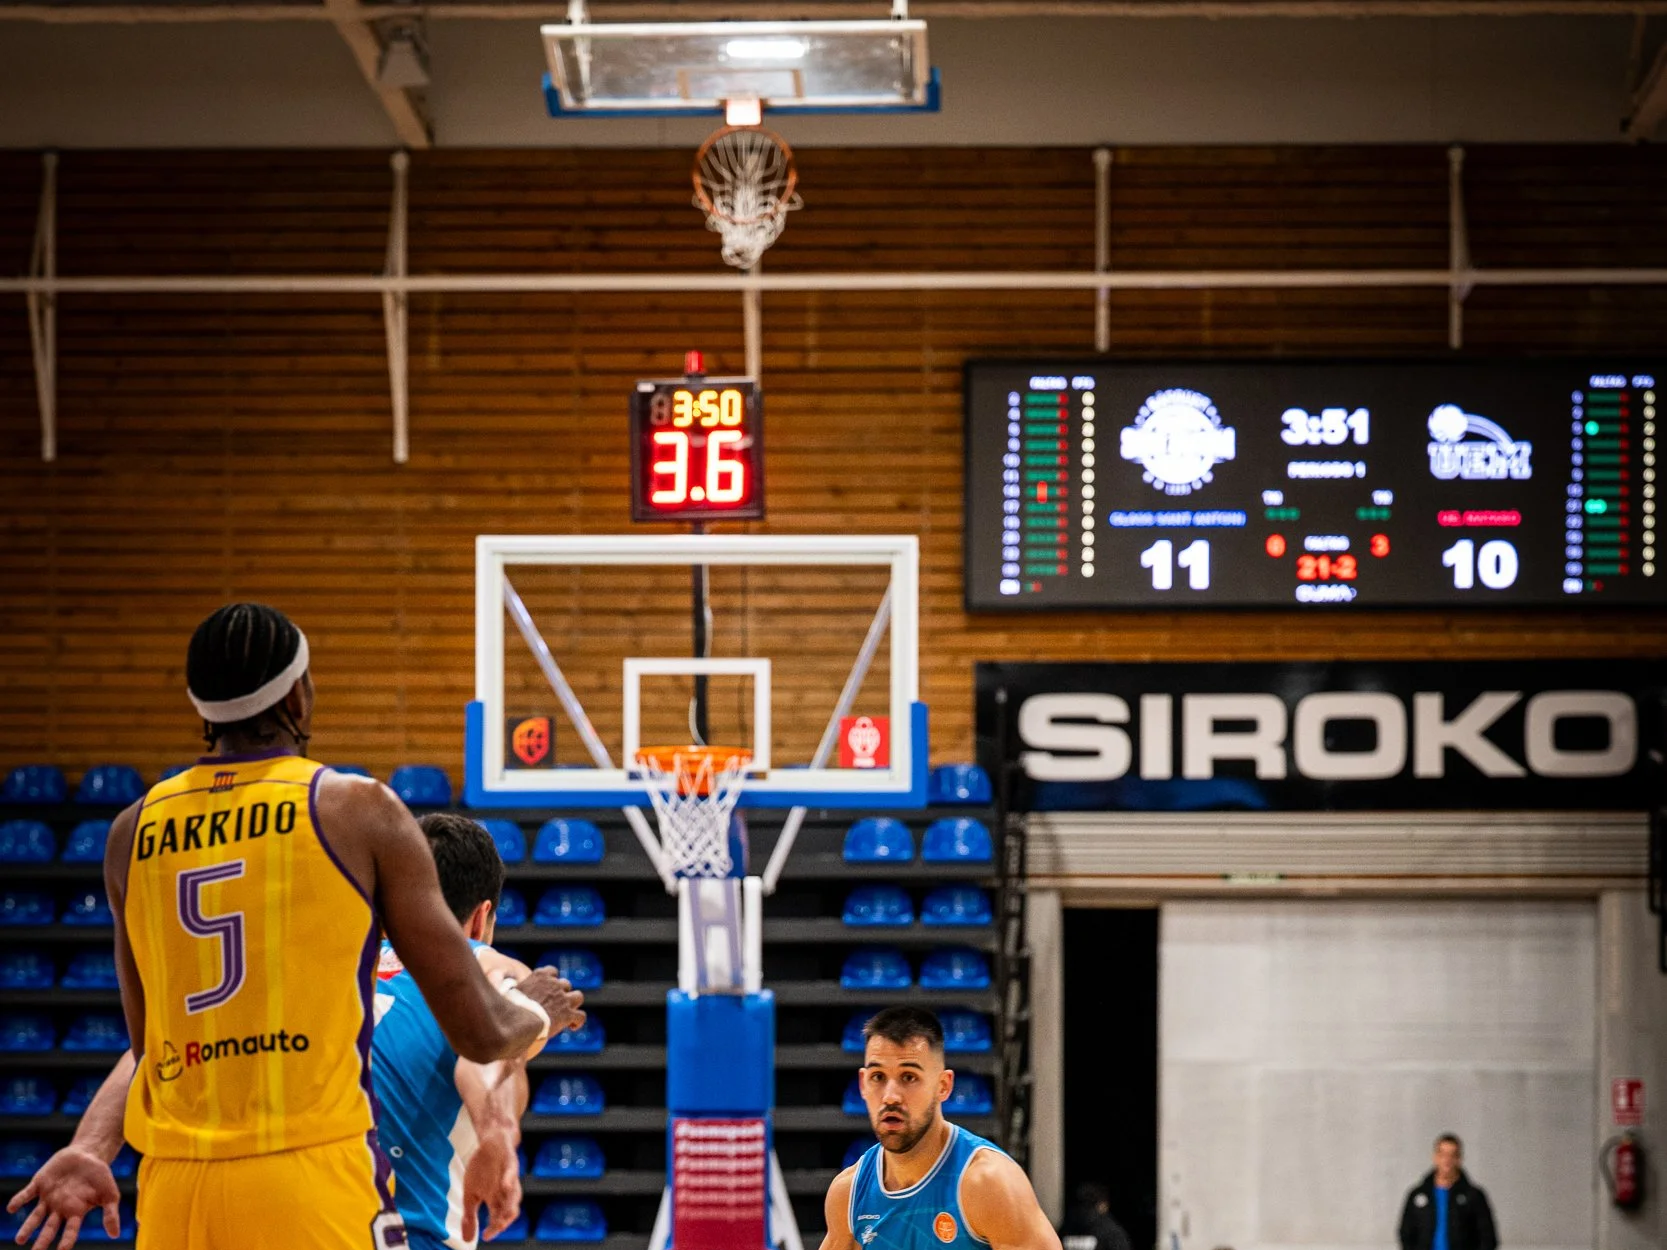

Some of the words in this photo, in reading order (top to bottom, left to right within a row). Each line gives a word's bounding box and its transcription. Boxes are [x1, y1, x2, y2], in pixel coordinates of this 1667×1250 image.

[673, 390, 742, 428] 3:50
[1281, 408, 1369, 446] 3:51
[651, 430, 745, 504] 3.6
[1140, 539, 1209, 590] 11
[1442, 538, 1518, 589] 10
[1017, 690, 1639, 781] SIROKO
[137, 800, 297, 861] GARRIDO
[175, 858, 247, 1016] 5
[185, 1029, 309, 1067] Romauto
